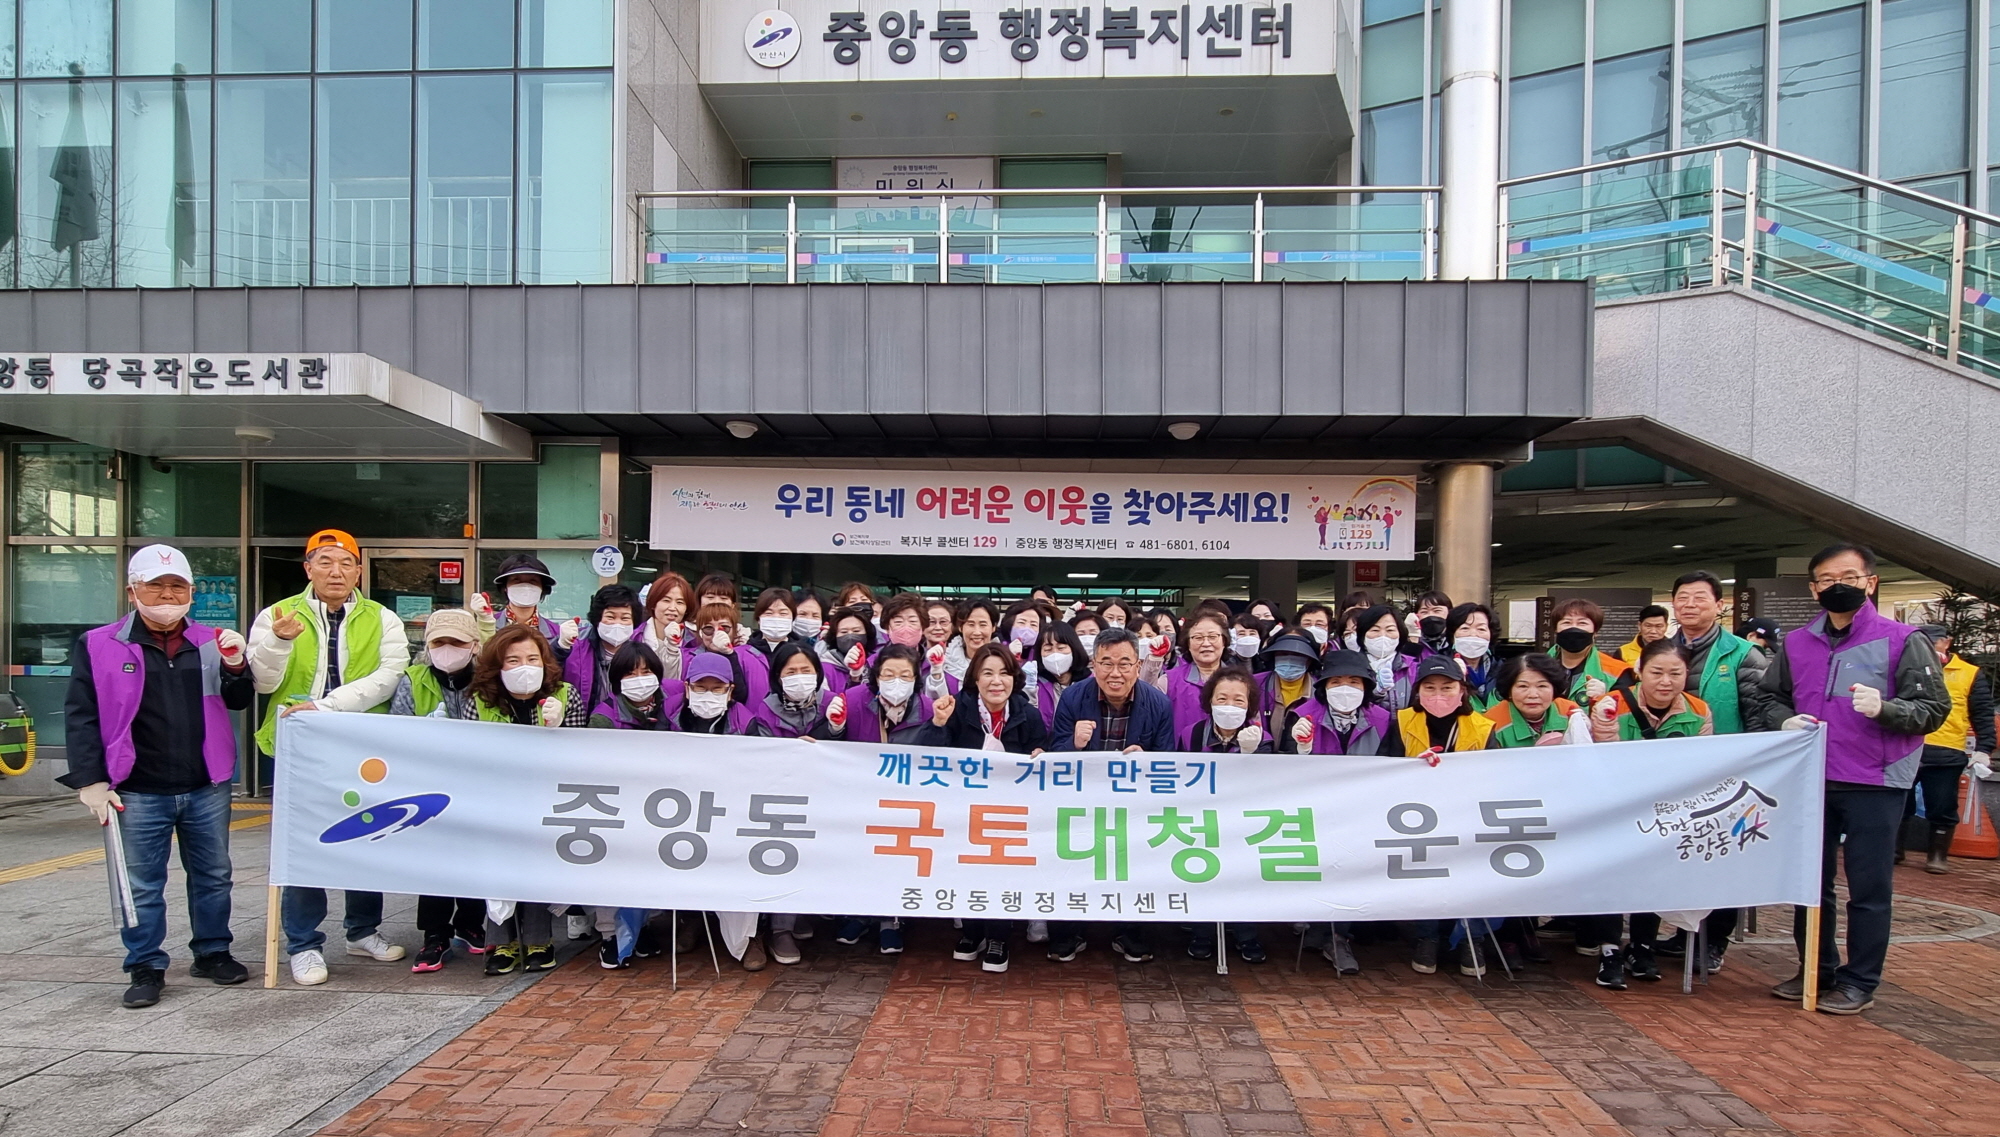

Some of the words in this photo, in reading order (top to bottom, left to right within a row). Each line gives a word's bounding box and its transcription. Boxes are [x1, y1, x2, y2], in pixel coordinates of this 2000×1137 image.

[823, 10, 978, 64] 중앙동
[999, 3, 1291, 61] 행정복지센터
[758, 51, 787, 60] 안산시
[83, 357, 328, 389] 당곡작은도서관
[775, 484, 834, 519] 우리
[845, 486, 905, 523] 동네
[916, 485, 1014, 524] 어려운
[1024, 485, 1113, 526] 이웃을
[1123, 488, 1290, 526] 찾아주세요!
[900, 536, 933, 548] 복지부
[937, 536, 969, 548] 콜센터
[973, 536, 997, 548] 129
[1015, 537, 1049, 550] 중앙동
[1052, 537, 1117, 551] 행정복지센터
[1139, 539, 1198, 551] 481-6801,
[1202, 540, 1231, 551] 6104
[1350, 529, 1373, 540] 129
[601, 557, 615, 567] 76
[1543, 600, 1551, 626] 안산시
[1740, 591, 1750, 622] 중앙동
[877, 752, 993, 790] 깨끗한
[1014, 760, 1083, 792] 거리
[1107, 759, 1217, 794] 만들기
[541, 782, 816, 876] 중앙동
[865, 799, 1323, 883] 국토대청결
[1374, 799, 1557, 880] 운동
[1676, 830, 1732, 861] 중앙동
[901, 887, 1189, 915] 중앙동행정복지센터
